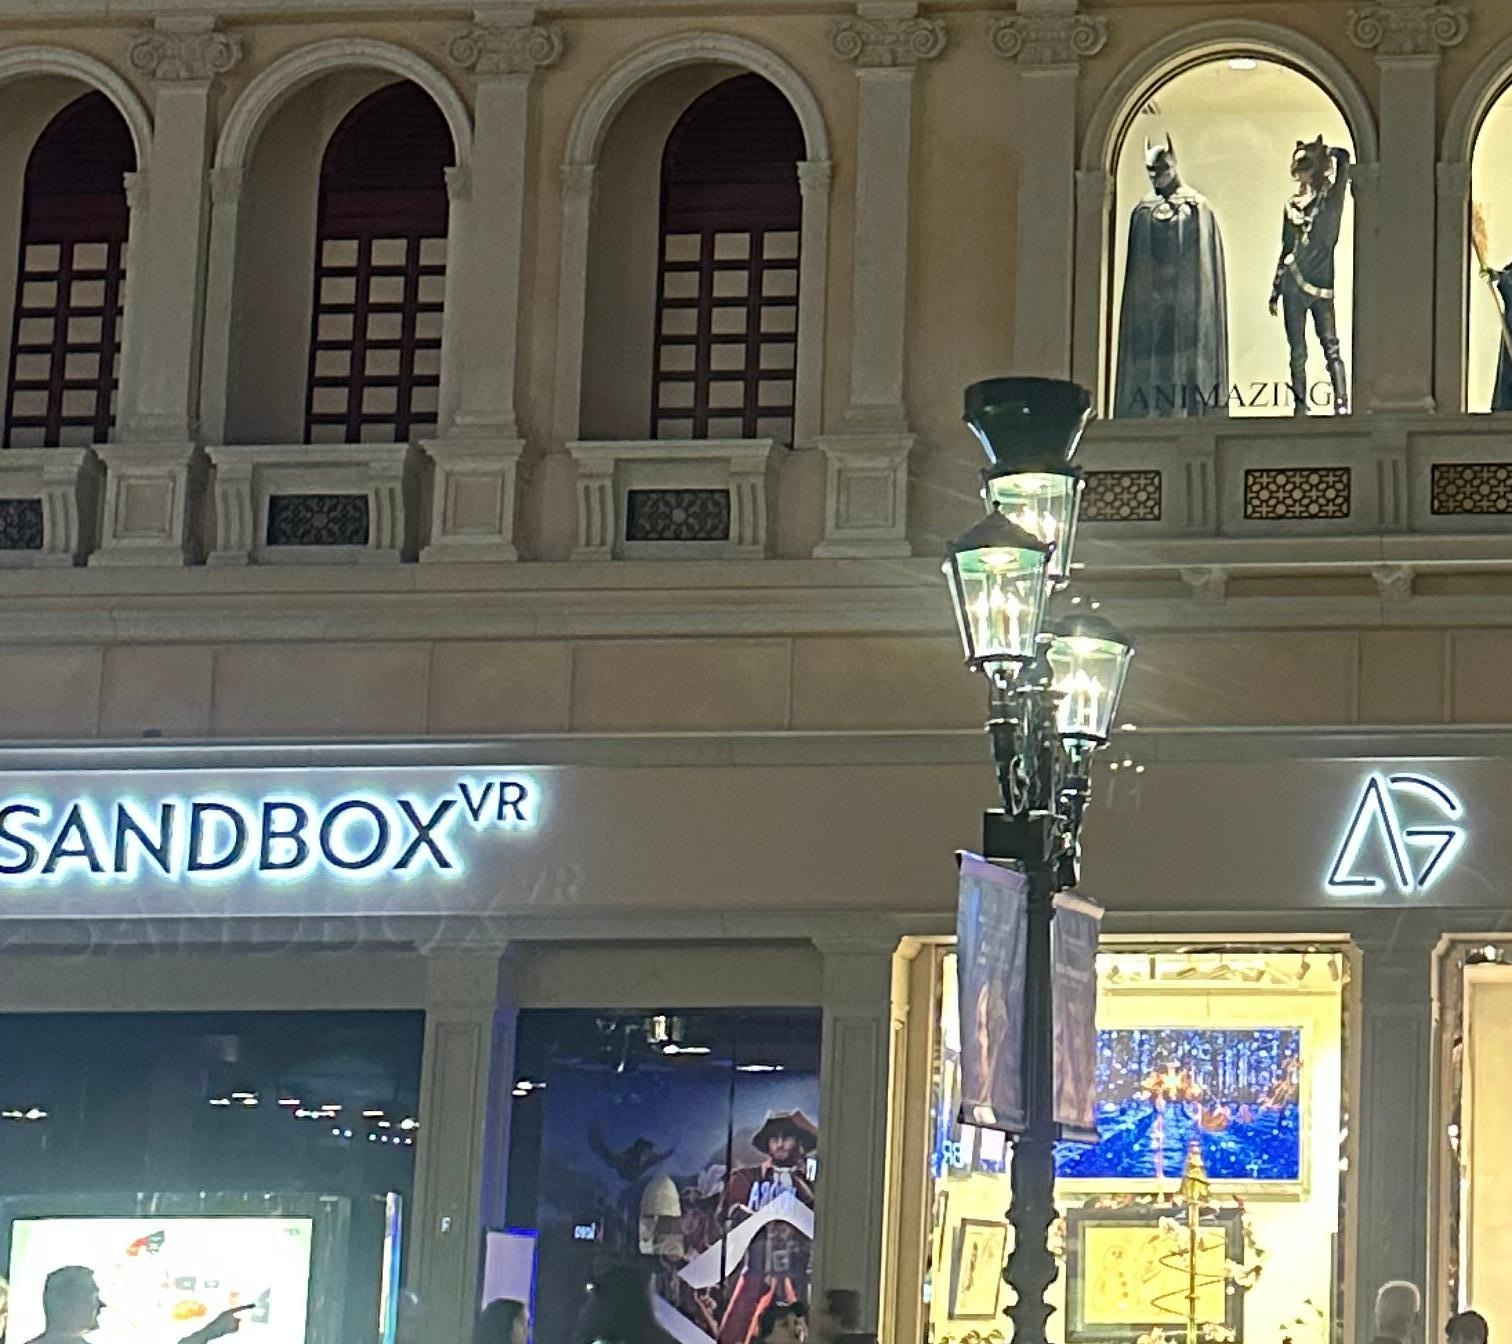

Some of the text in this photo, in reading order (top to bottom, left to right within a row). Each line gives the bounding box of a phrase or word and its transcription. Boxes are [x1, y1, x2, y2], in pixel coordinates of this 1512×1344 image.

[1127, 380, 1333, 411] ANIMAZING
[0, 781, 528, 875] SANDBOX VR
